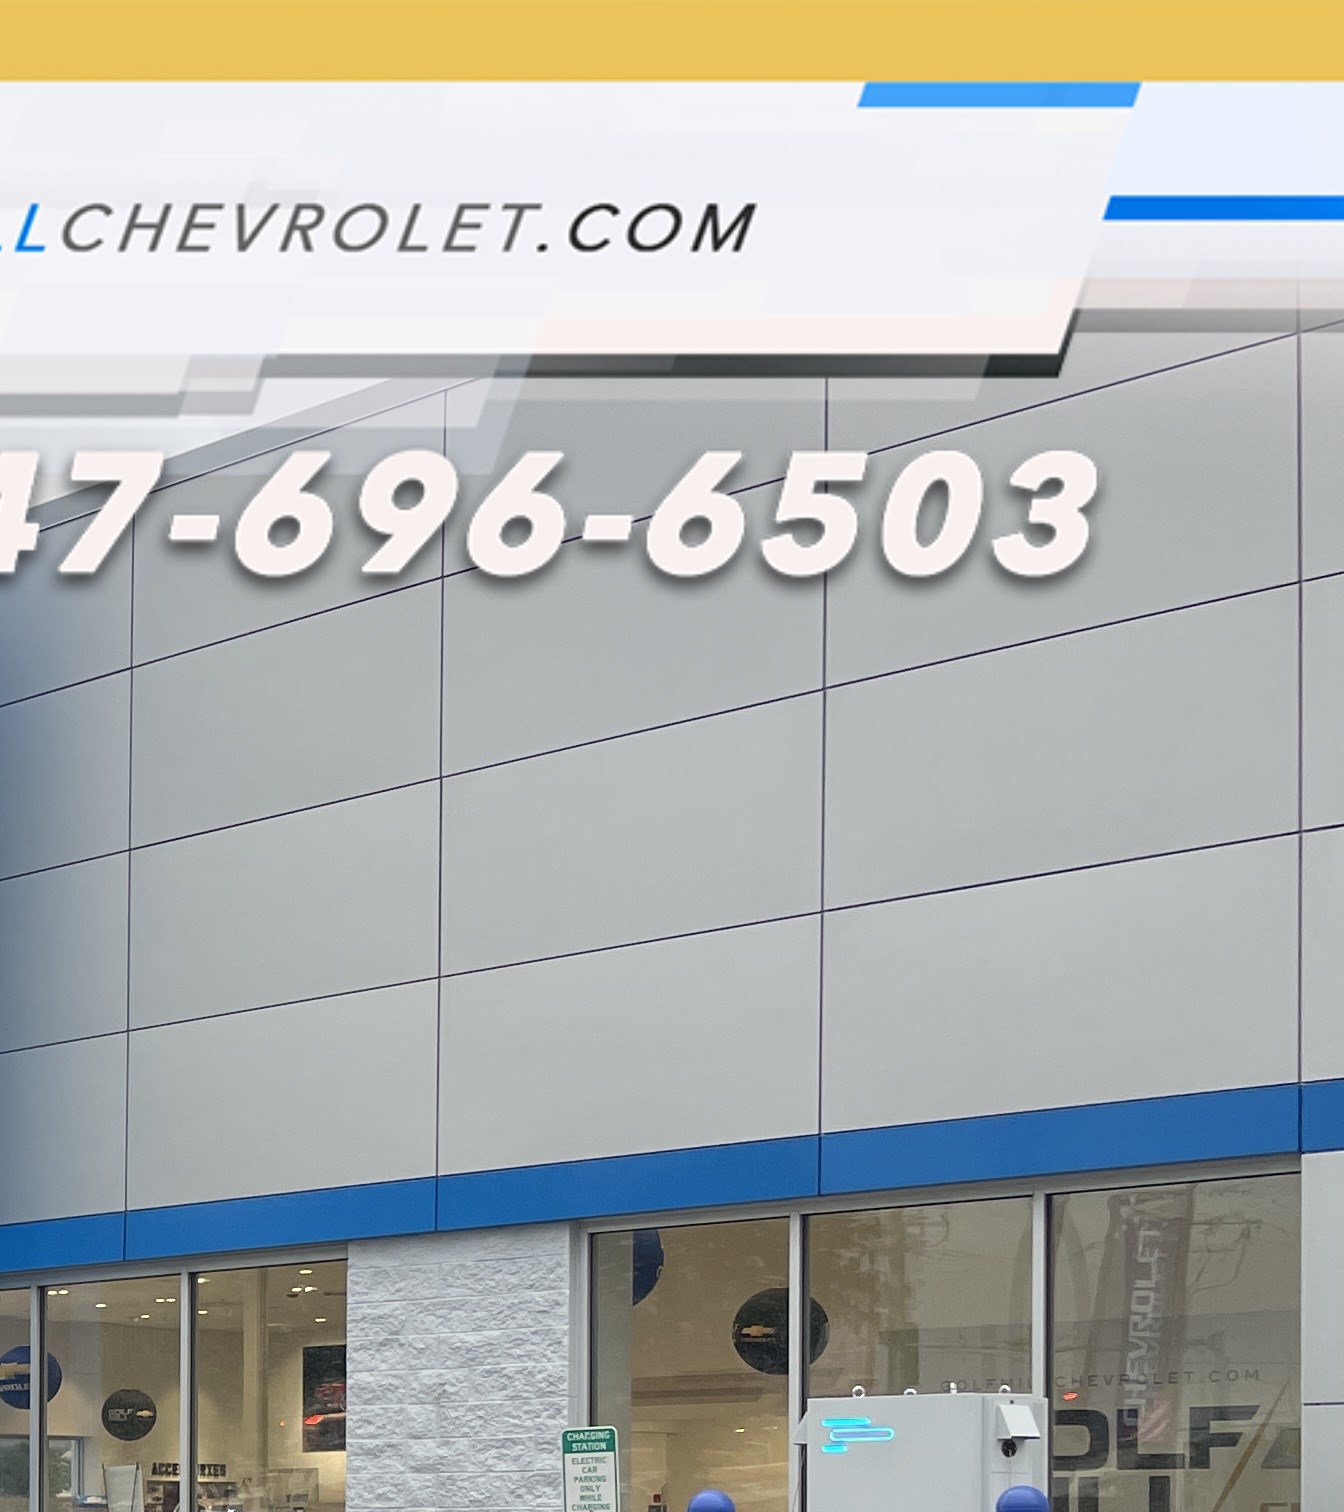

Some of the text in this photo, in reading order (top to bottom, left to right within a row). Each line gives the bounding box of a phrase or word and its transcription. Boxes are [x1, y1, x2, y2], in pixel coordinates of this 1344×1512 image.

[566, 1430, 611, 1441] CHARGING
[1053, 1404, 1261, 1471] OLF
[572, 1441, 607, 1452] STATION
[572, 1456, 607, 1466] ELECTRIC
[152, 1462, 226, 1477] ACCERIES
[581, 1466, 598, 1474] CAR
[573, 1475, 607, 1483] PARKING
[579, 1484, 601, 1493] ONLY
[571, 1503, 610, 1512] CHARGING
